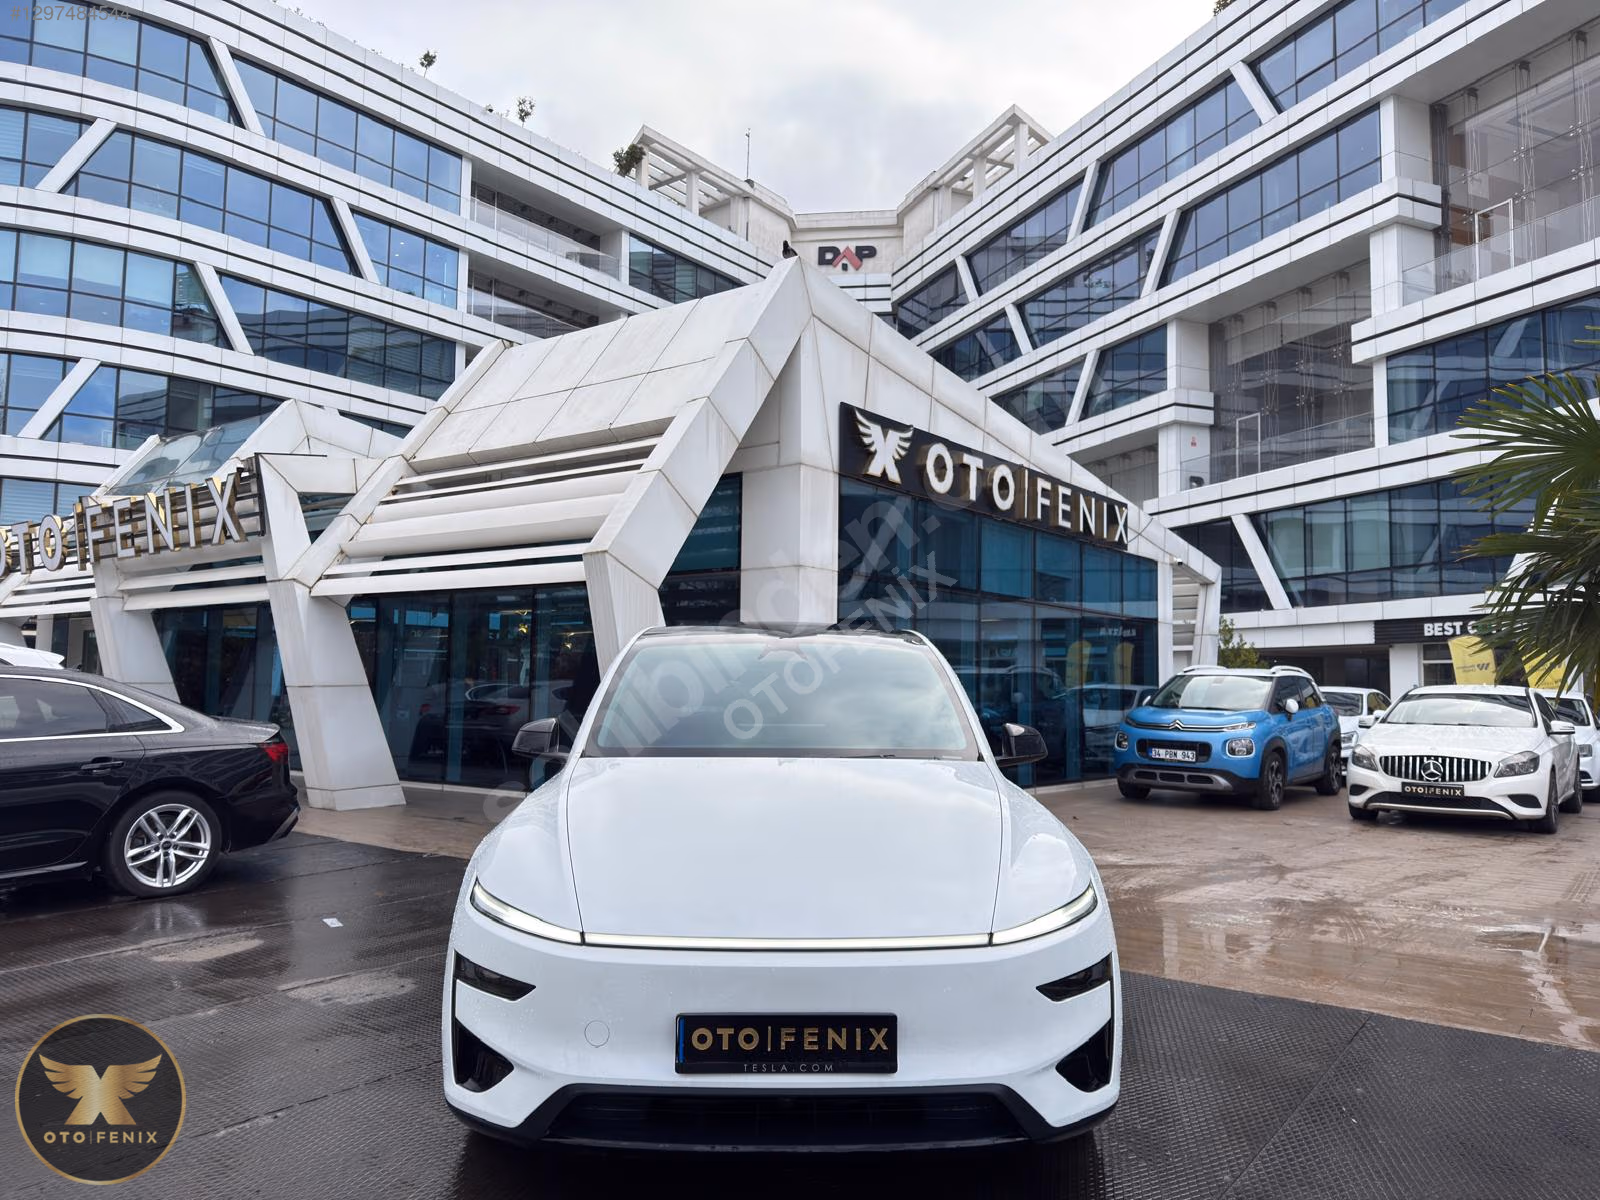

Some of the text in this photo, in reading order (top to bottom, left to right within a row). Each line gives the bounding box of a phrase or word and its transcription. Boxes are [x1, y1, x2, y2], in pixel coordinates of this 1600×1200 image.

[818, 245, 877, 271] DAP
[0, 514, 64, 578] TO
[1423, 621, 1463, 636] BEST
[743, 1063, 834, 1073] TESLA.COM
